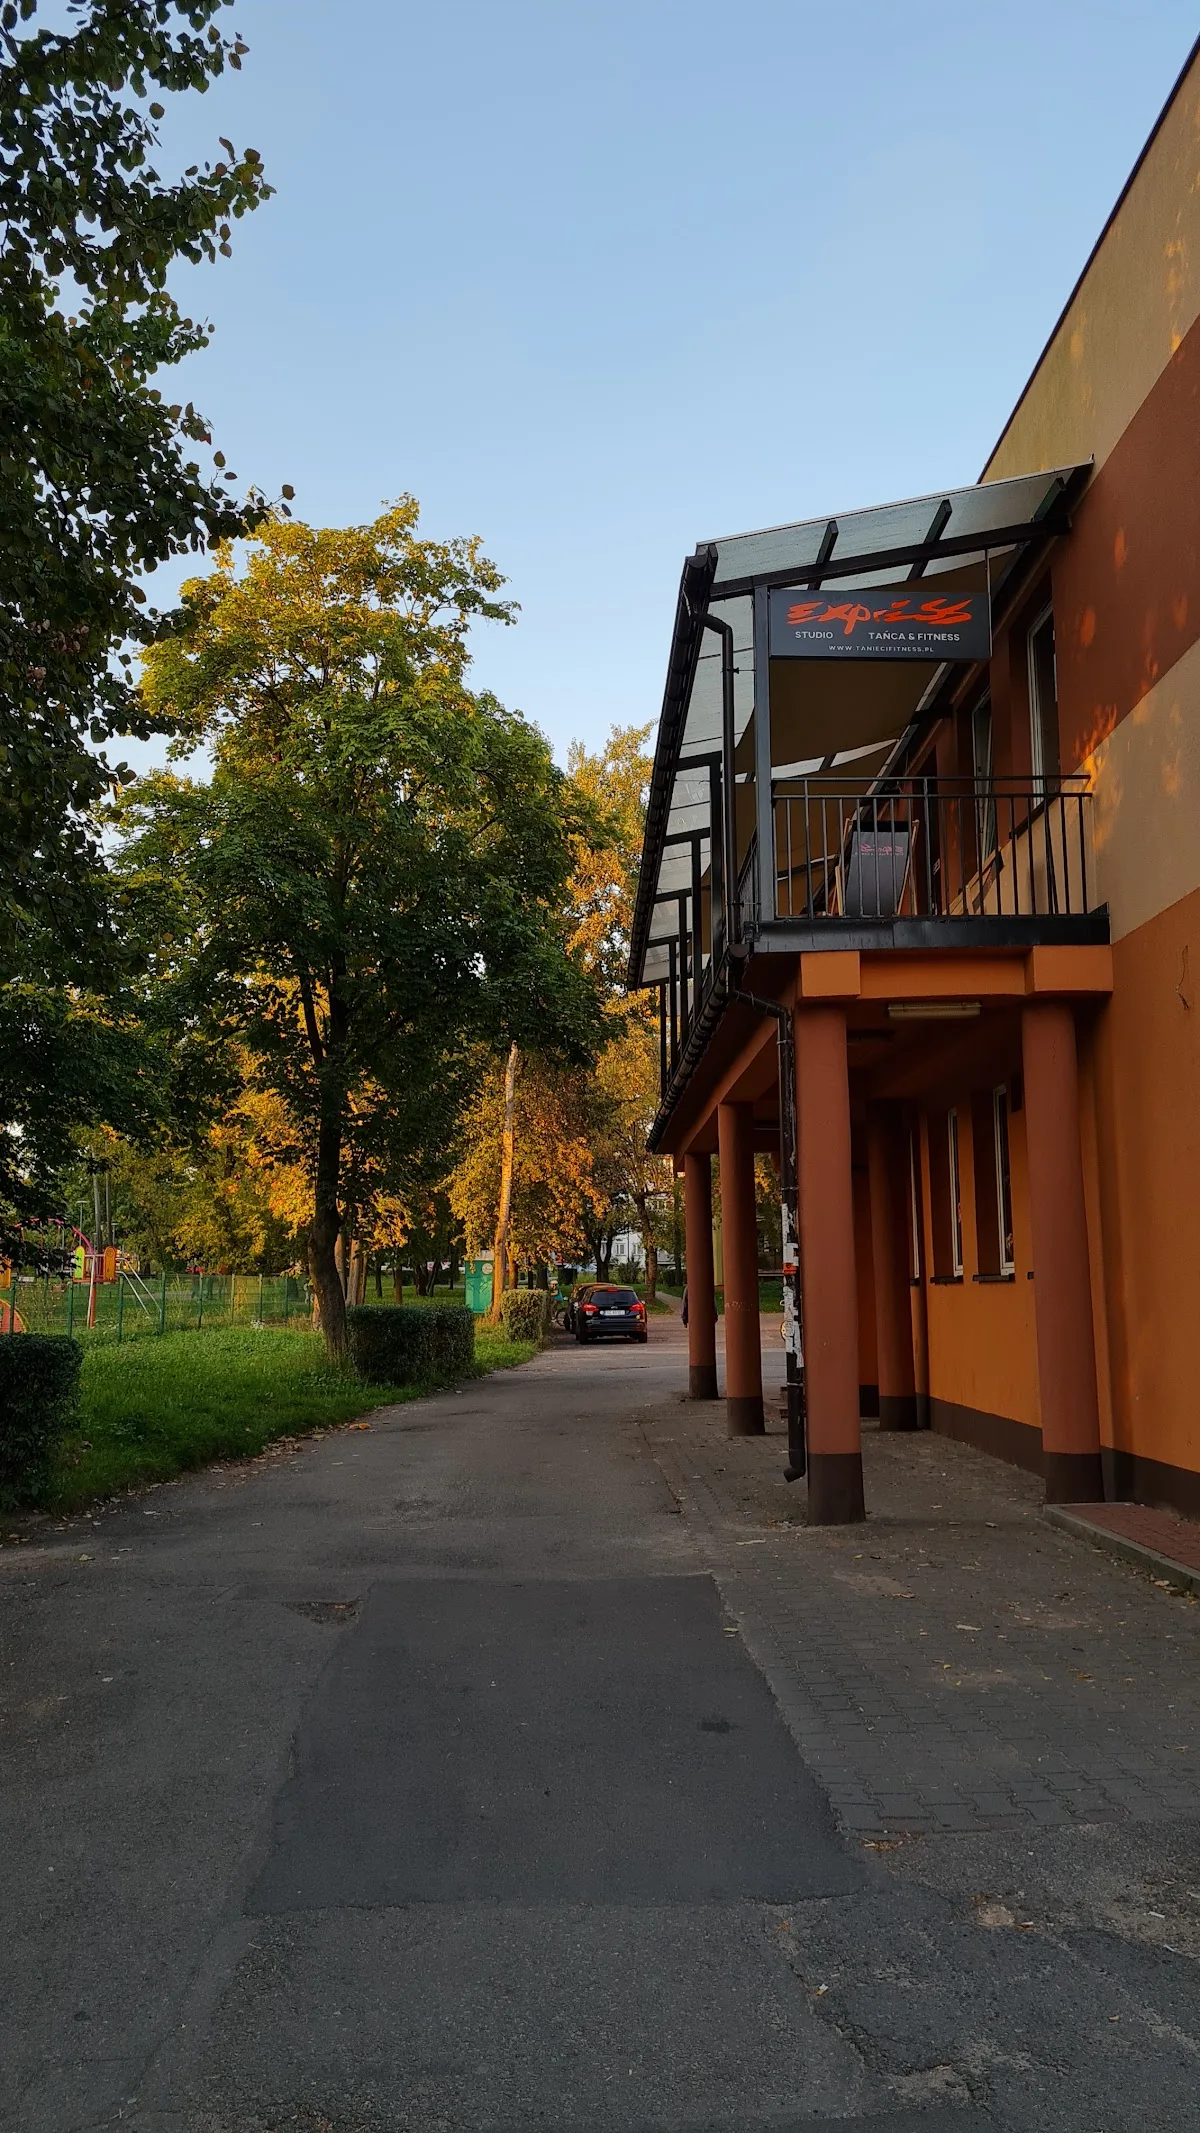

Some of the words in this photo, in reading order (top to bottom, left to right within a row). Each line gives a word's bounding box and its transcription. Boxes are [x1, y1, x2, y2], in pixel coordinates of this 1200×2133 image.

[795, 631, 834, 639] STUDIO
[868, 630, 906, 641] TAŃCA
[918, 633, 960, 641] FITNESS
[828, 645, 934, 653] WWW.TANIECIFITNESS.PL
